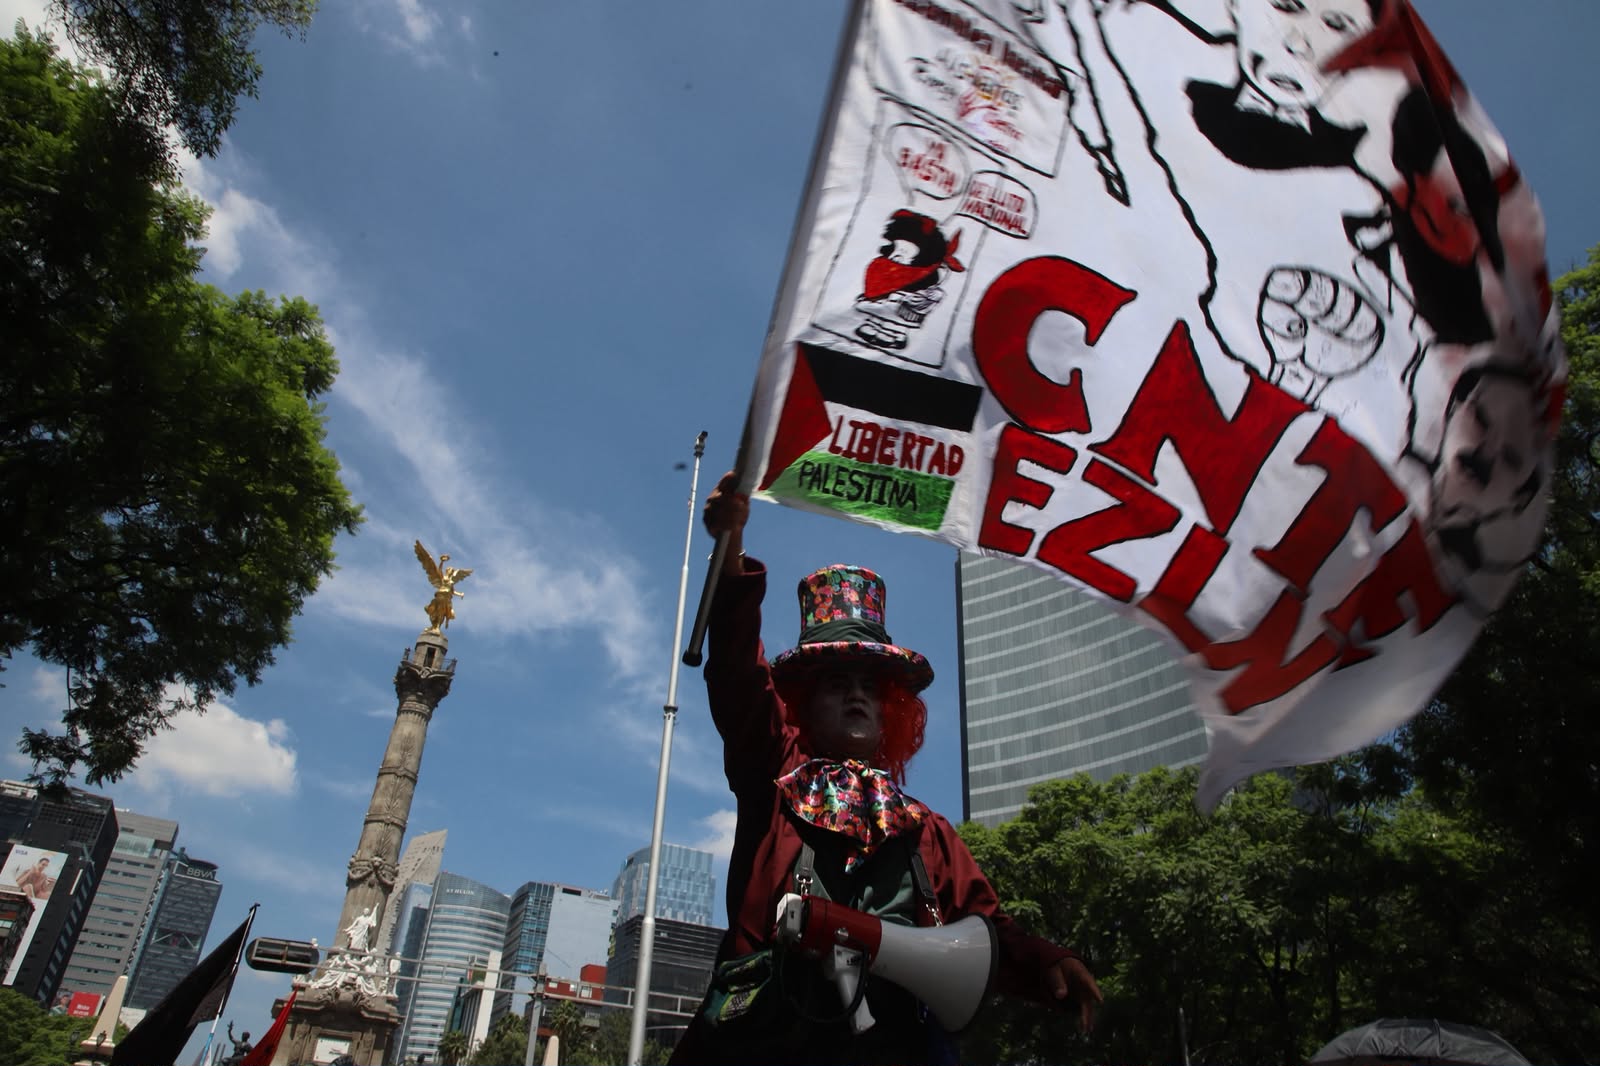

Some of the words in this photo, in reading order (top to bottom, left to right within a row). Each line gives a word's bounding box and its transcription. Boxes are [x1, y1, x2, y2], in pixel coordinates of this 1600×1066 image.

[828, 415, 965, 477] LIBERTAD
[798, 460, 918, 511] PALESTINA
[186, 867, 214, 879] BBVA
